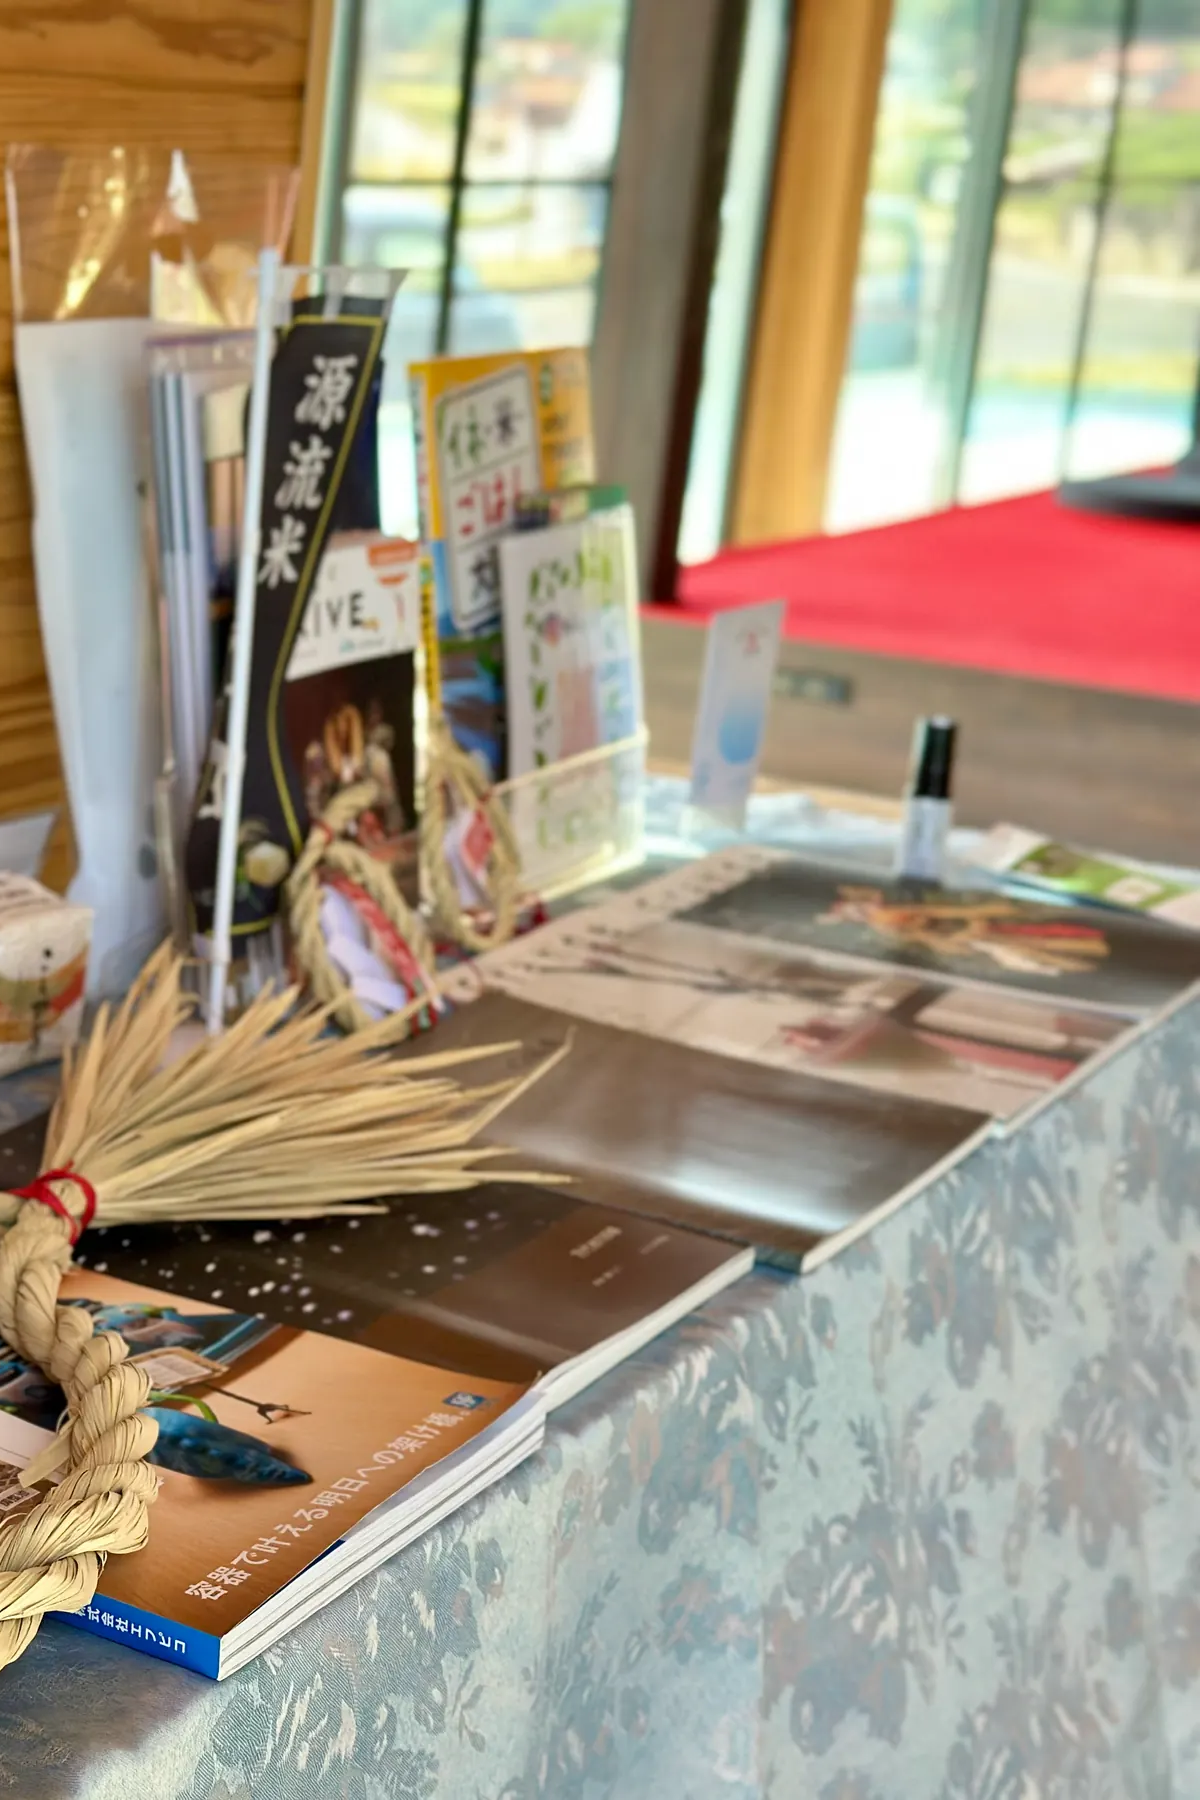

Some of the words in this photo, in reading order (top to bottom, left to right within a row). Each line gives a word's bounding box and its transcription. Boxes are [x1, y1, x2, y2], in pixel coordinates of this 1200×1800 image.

[257, 353, 360, 589] 源流米
[184, 1408, 472, 1601] 容器で叶える明日への架け橋。
